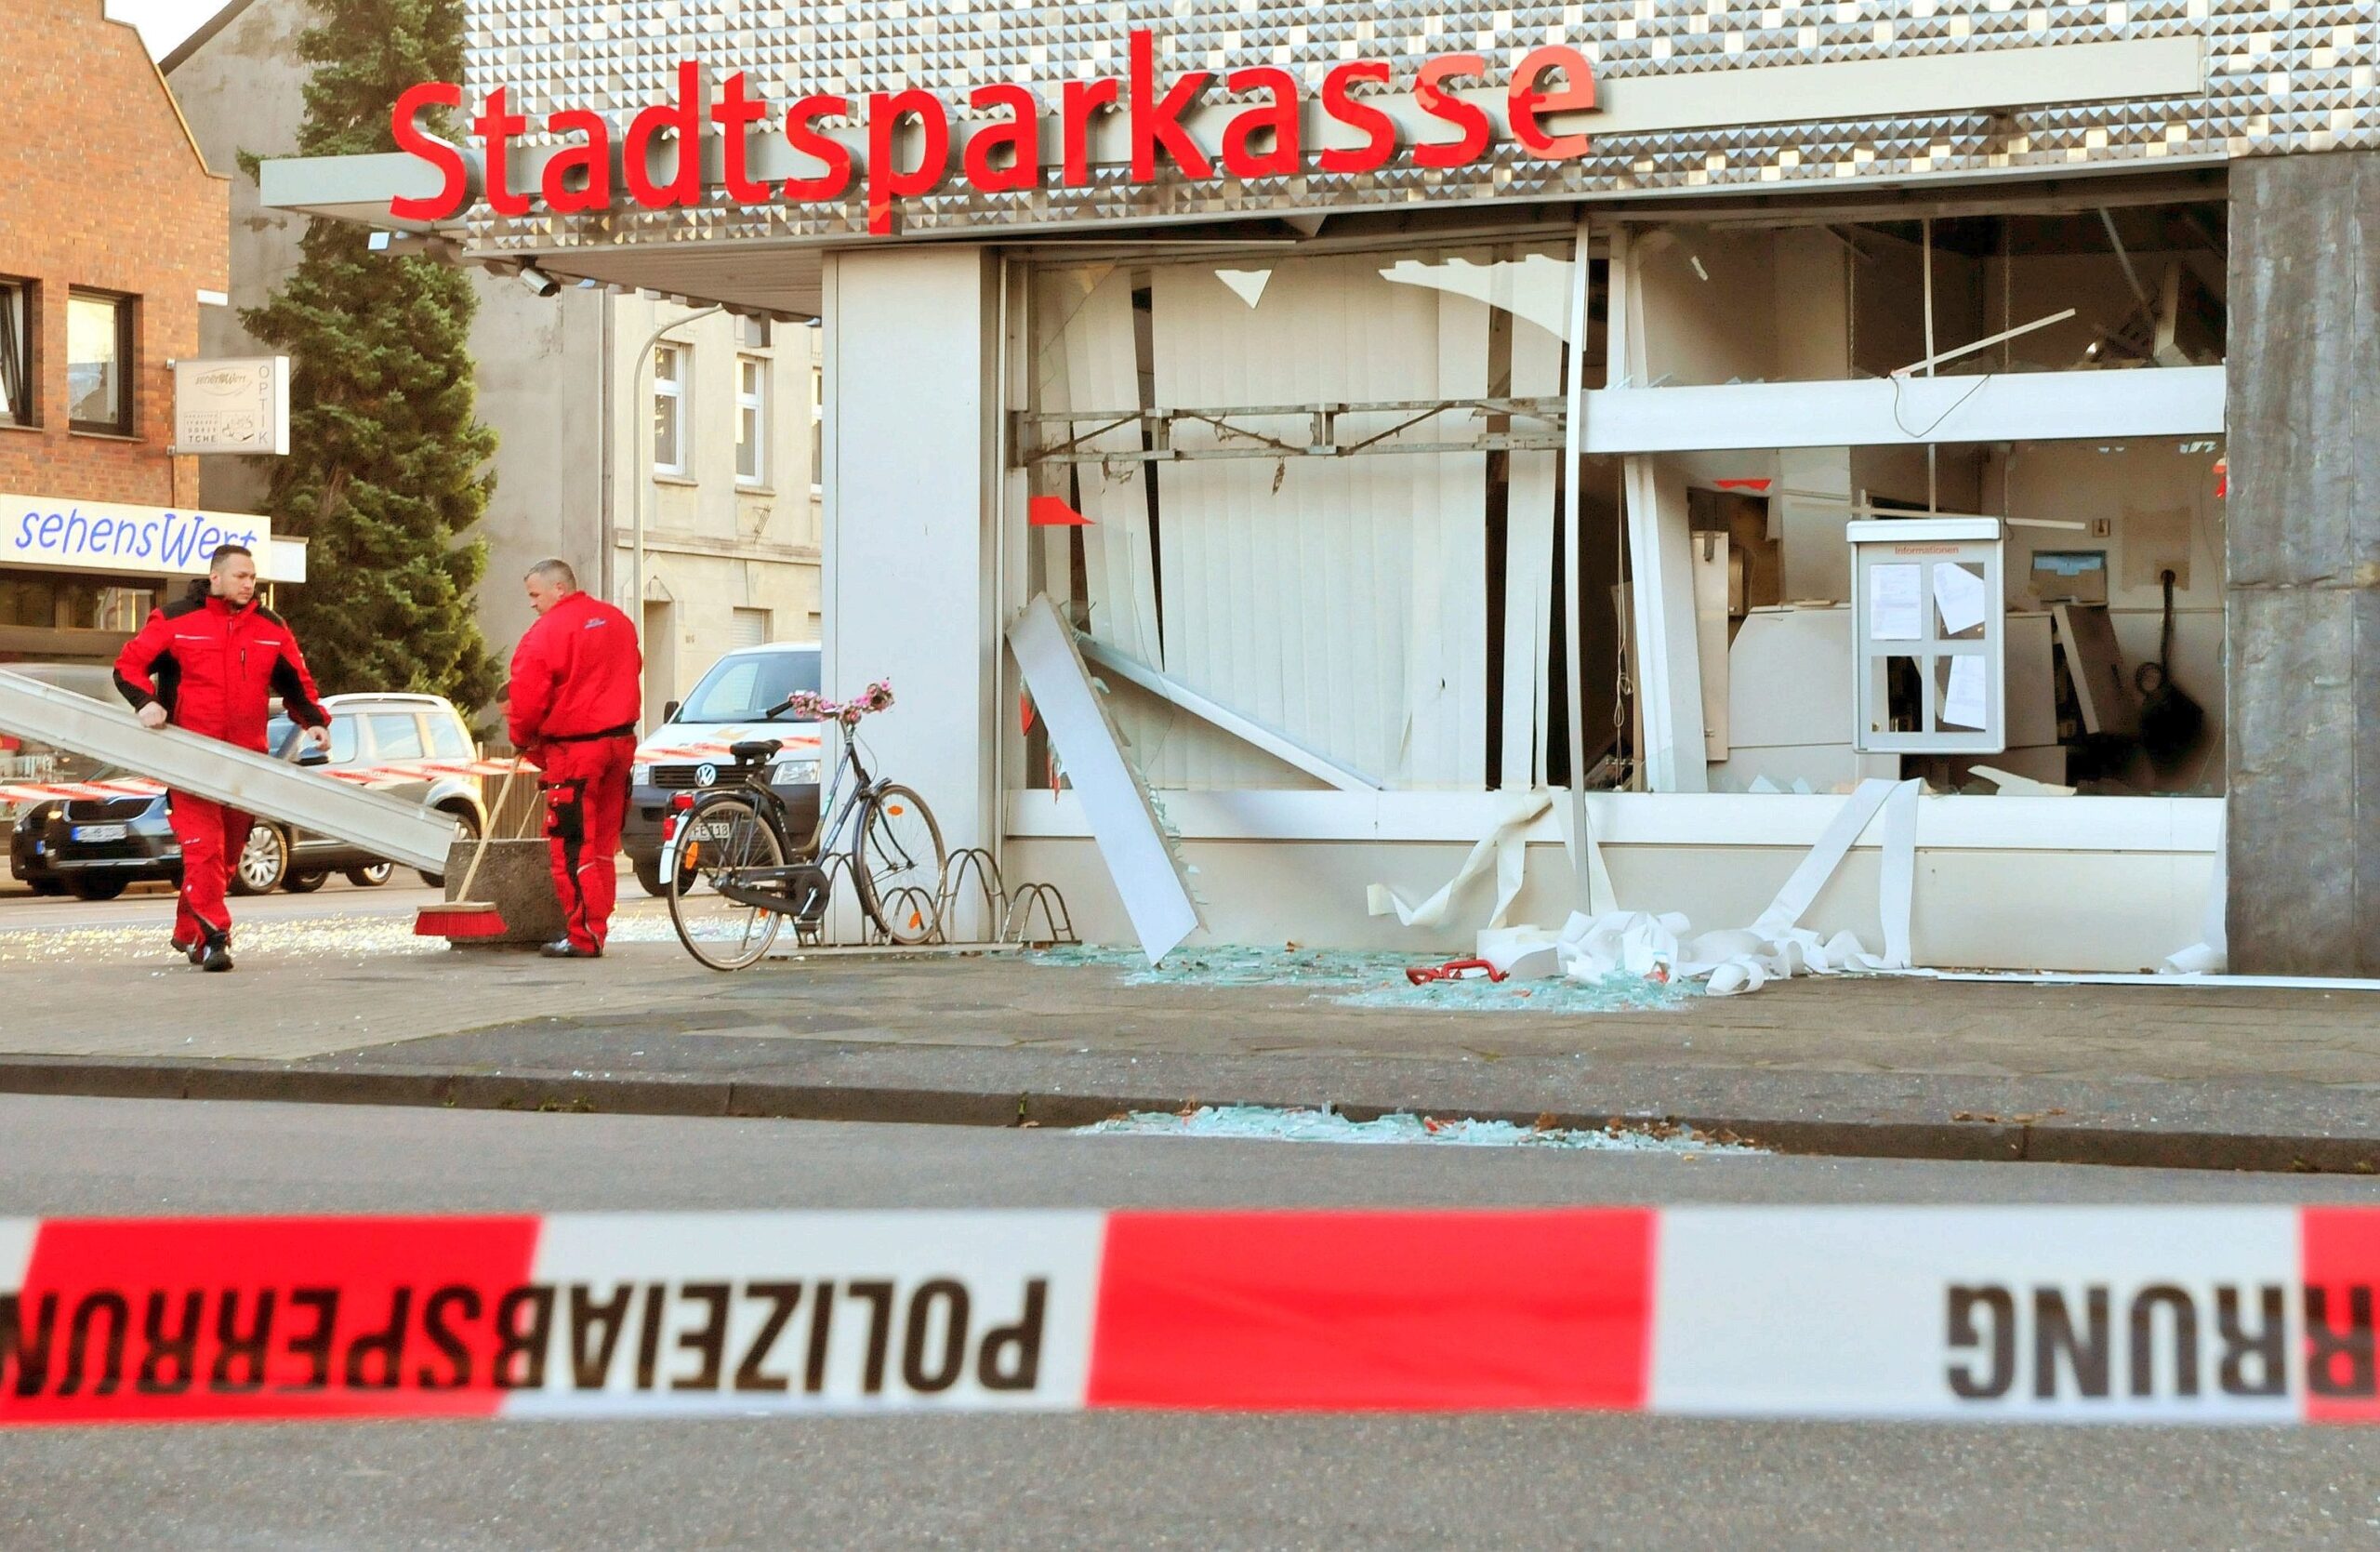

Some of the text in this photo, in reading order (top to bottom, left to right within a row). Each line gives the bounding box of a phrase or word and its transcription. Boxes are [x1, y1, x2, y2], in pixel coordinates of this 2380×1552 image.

[390, 29, 1595, 234] Stadtsparkasse
[259, 365, 270, 444] OPTIK
[16, 508, 258, 567] sehensWert
[1895, 545, 1960, 555] Informationen
[1948, 1282, 2377, 1399] RRUNG
